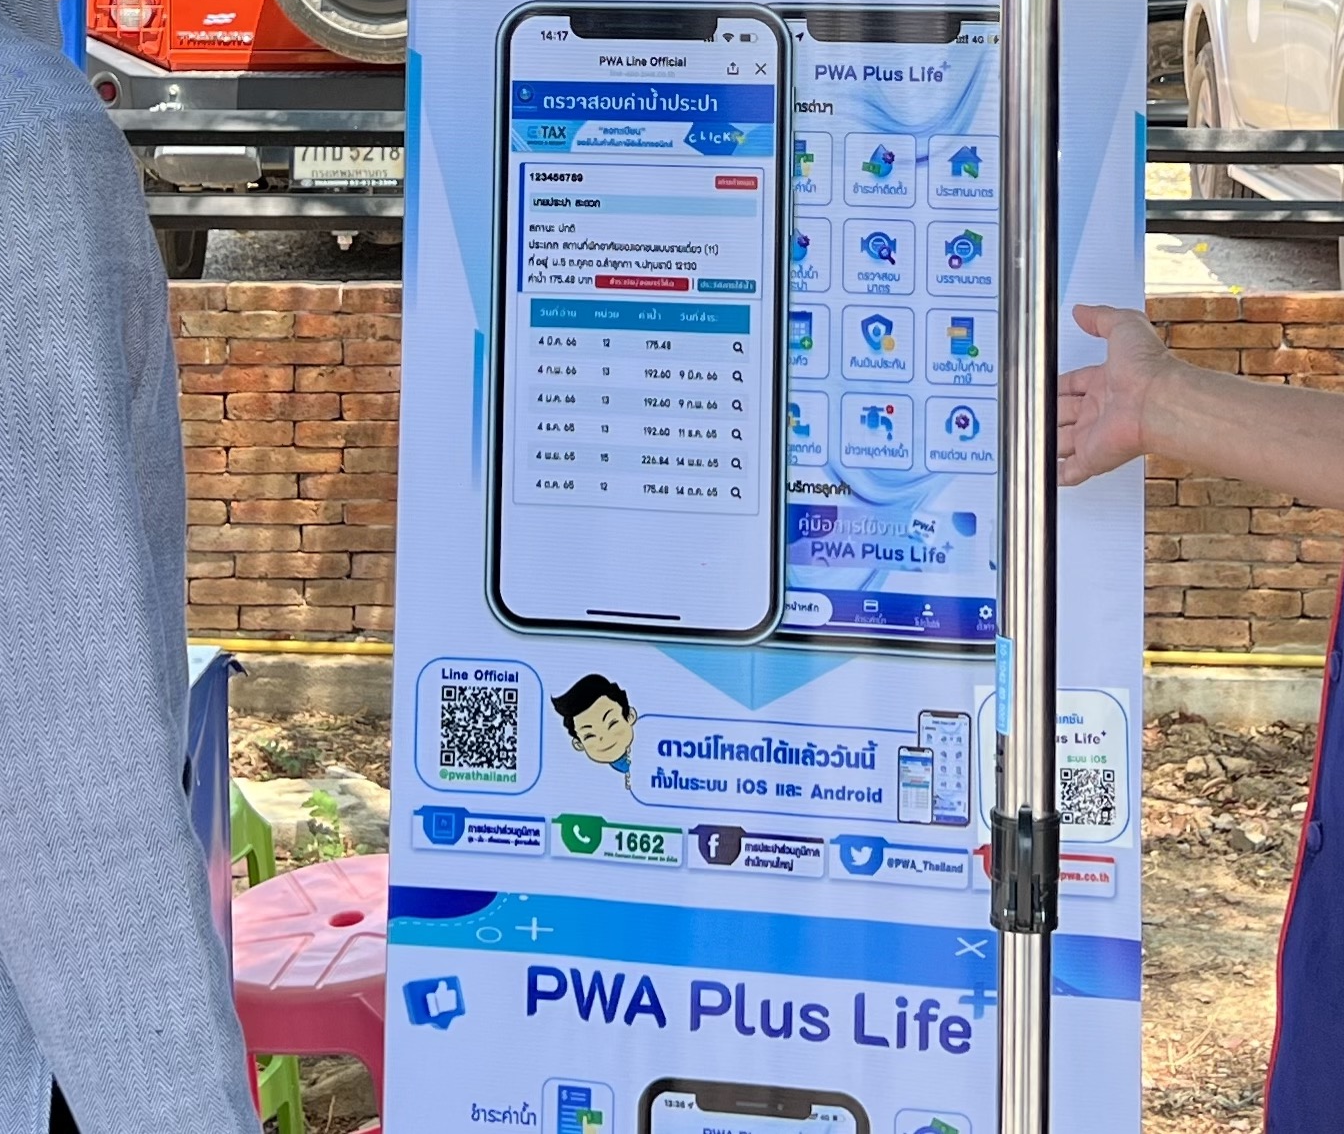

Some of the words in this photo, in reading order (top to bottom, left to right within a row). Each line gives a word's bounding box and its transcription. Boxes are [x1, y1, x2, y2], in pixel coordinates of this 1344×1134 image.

[540, 30, 568, 42] 14:17
[599, 56, 623, 67] PWA
[626, 56, 647, 67] Line
[650, 56, 686, 67] Official
[814, 64, 857, 81] PWA
[863, 65, 903, 82] Plus
[543, 87, 718, 112] ตรวจสอบค่าน้ำประปา
[788, 480, 851, 498] บริการลูกค้า
[811, 541, 855, 559] PWA
[861, 543, 905, 562] Plus
[441, 668, 468, 681] Line
[474, 669, 519, 682] Official
[657, 734, 878, 770] ดาวน์โหลดได้แล้ววันนี้
[439, 768, 517, 783] @pwathailand
[651, 767, 727, 793] ทั้งในระบบ
[736, 778, 767, 795] iOS
[775, 781, 802, 797] และ
[810, 783, 883, 804] Android
[615, 831, 664, 854] 1662
[887, 858, 964, 874] @PWA_Thailand
[1060, 872, 1110, 883] pwa.co.th
[526, 965, 666, 1030] PWA
[690, 979, 831, 1044] Plus
